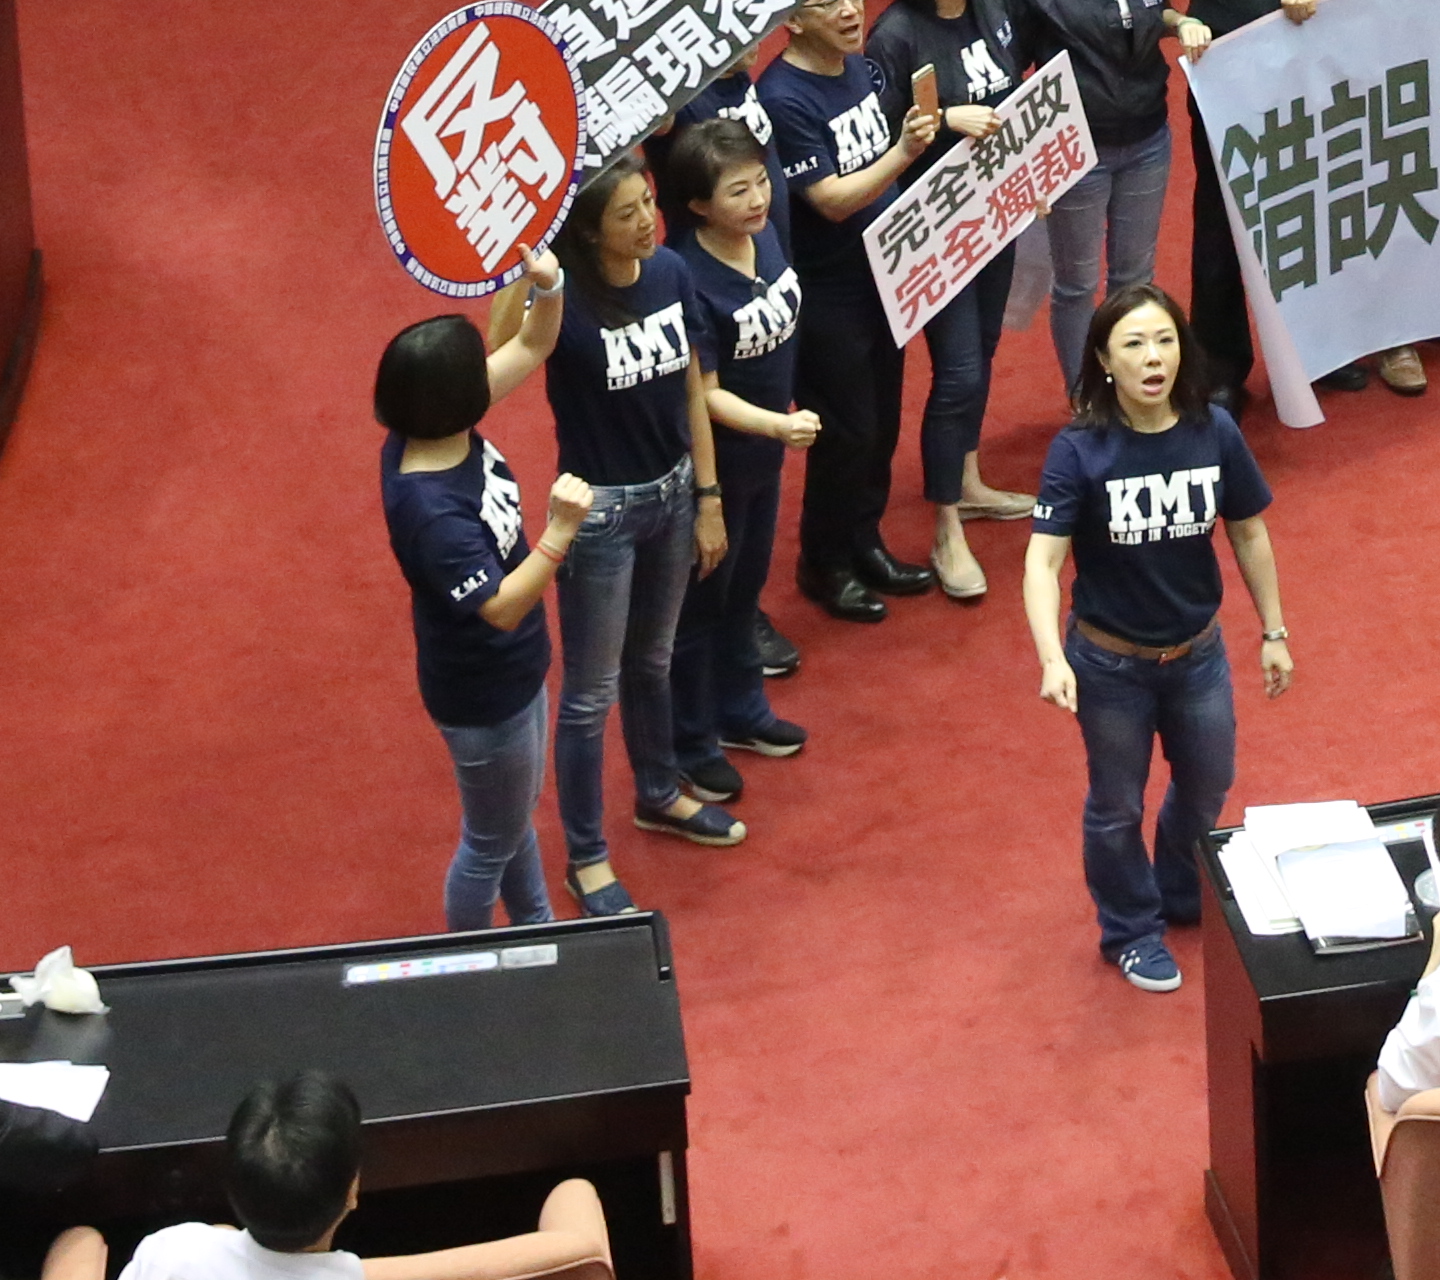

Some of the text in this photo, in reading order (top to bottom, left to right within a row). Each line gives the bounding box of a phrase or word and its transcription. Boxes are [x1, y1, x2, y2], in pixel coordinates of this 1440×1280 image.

[401, 21, 567, 274] 反對
[827, 91, 890, 165] KMT
[878, 70, 1071, 276] 完全執政
[895, 124, 1088, 330] 完全獨裁
[599, 301, 692, 378] KMT
[1105, 465, 1221, 533] KMT
[1110, 518, 1216, 546] LEAN IN TOGET
